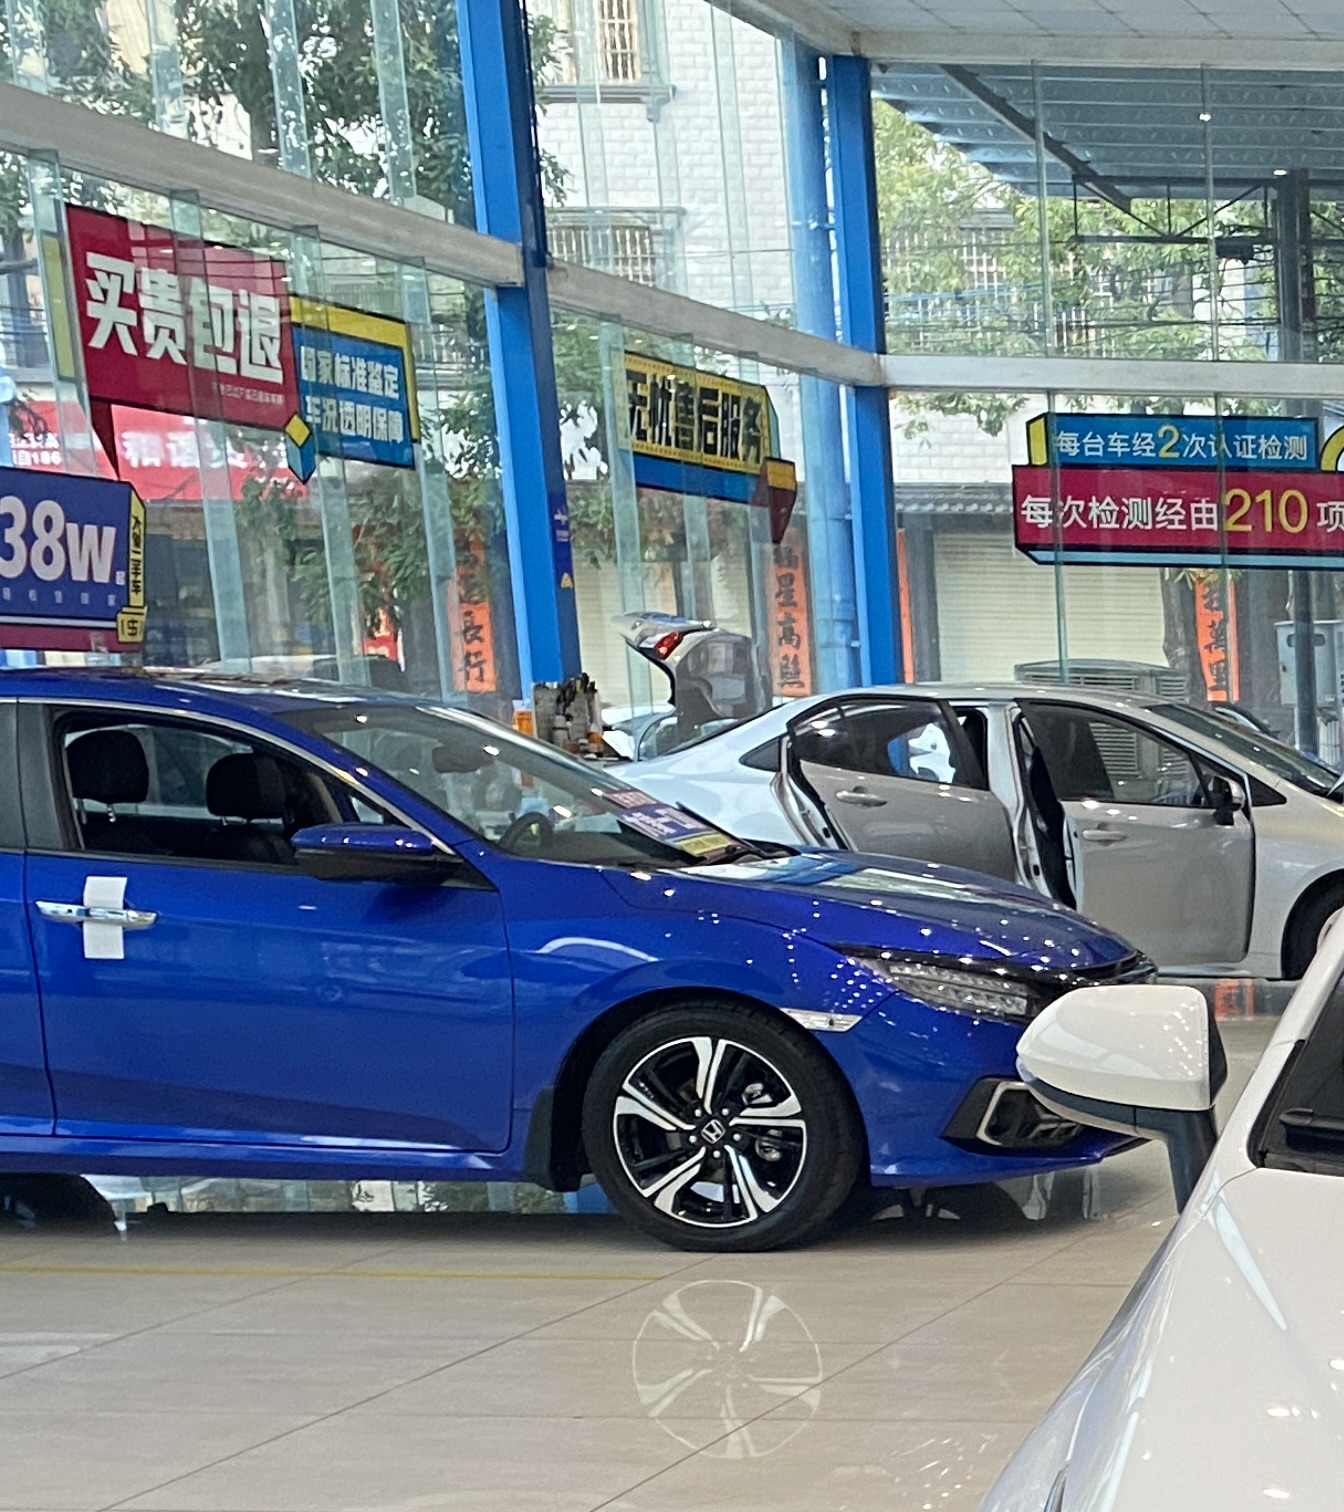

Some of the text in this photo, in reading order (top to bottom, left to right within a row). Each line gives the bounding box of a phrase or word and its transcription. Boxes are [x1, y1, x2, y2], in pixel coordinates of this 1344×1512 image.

[86, 252, 283, 385] 买贵包退
[306, 395, 404, 444] 车况透明保障
[625, 368, 763, 465] 无忧售后服务
[1056, 424, 1308, 461] 每台车经2次认证检测
